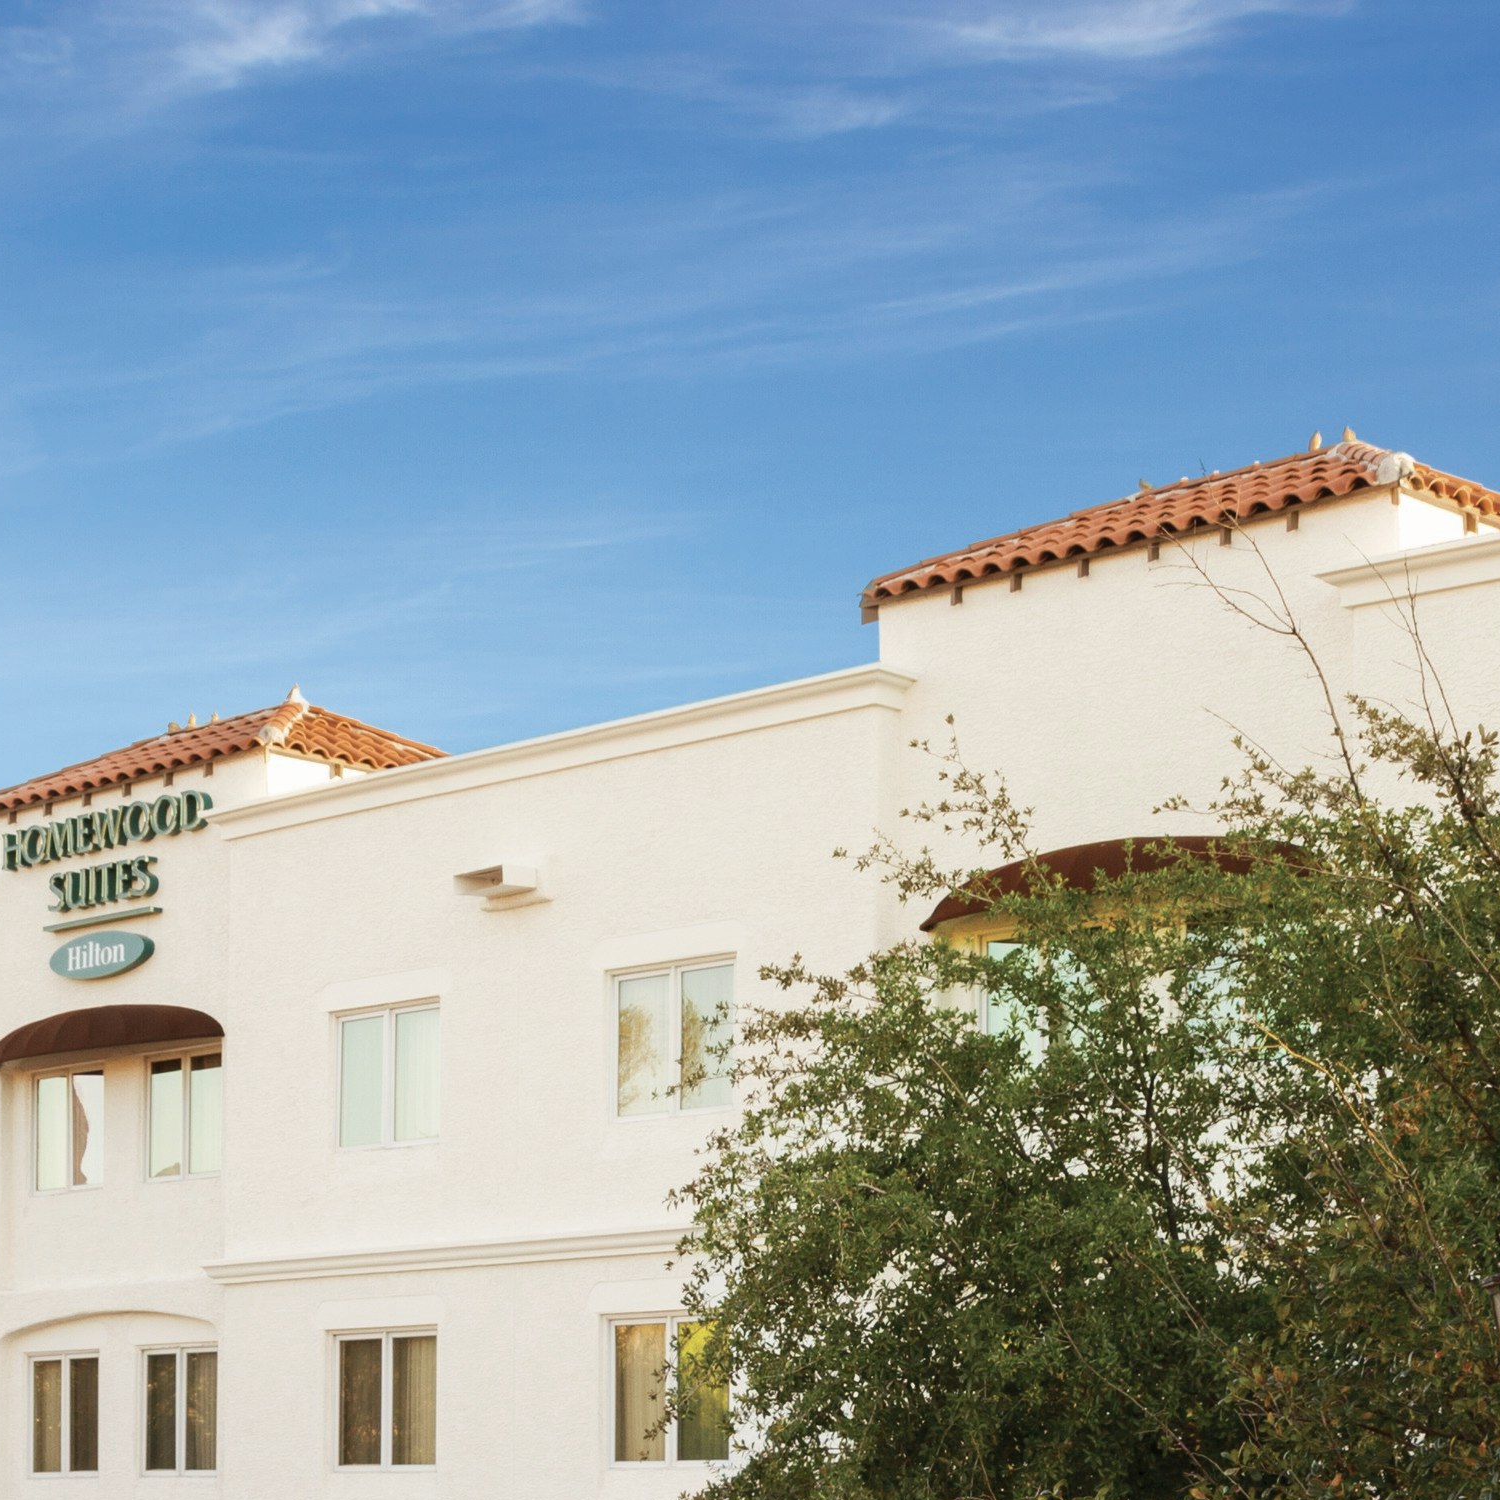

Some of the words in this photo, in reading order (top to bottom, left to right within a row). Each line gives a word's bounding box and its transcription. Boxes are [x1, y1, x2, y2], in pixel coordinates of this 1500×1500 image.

[2, 790, 213, 871] HOMEWOOD
[48, 855, 159, 912] SUITES
[67, 941, 125, 972] Hilton
